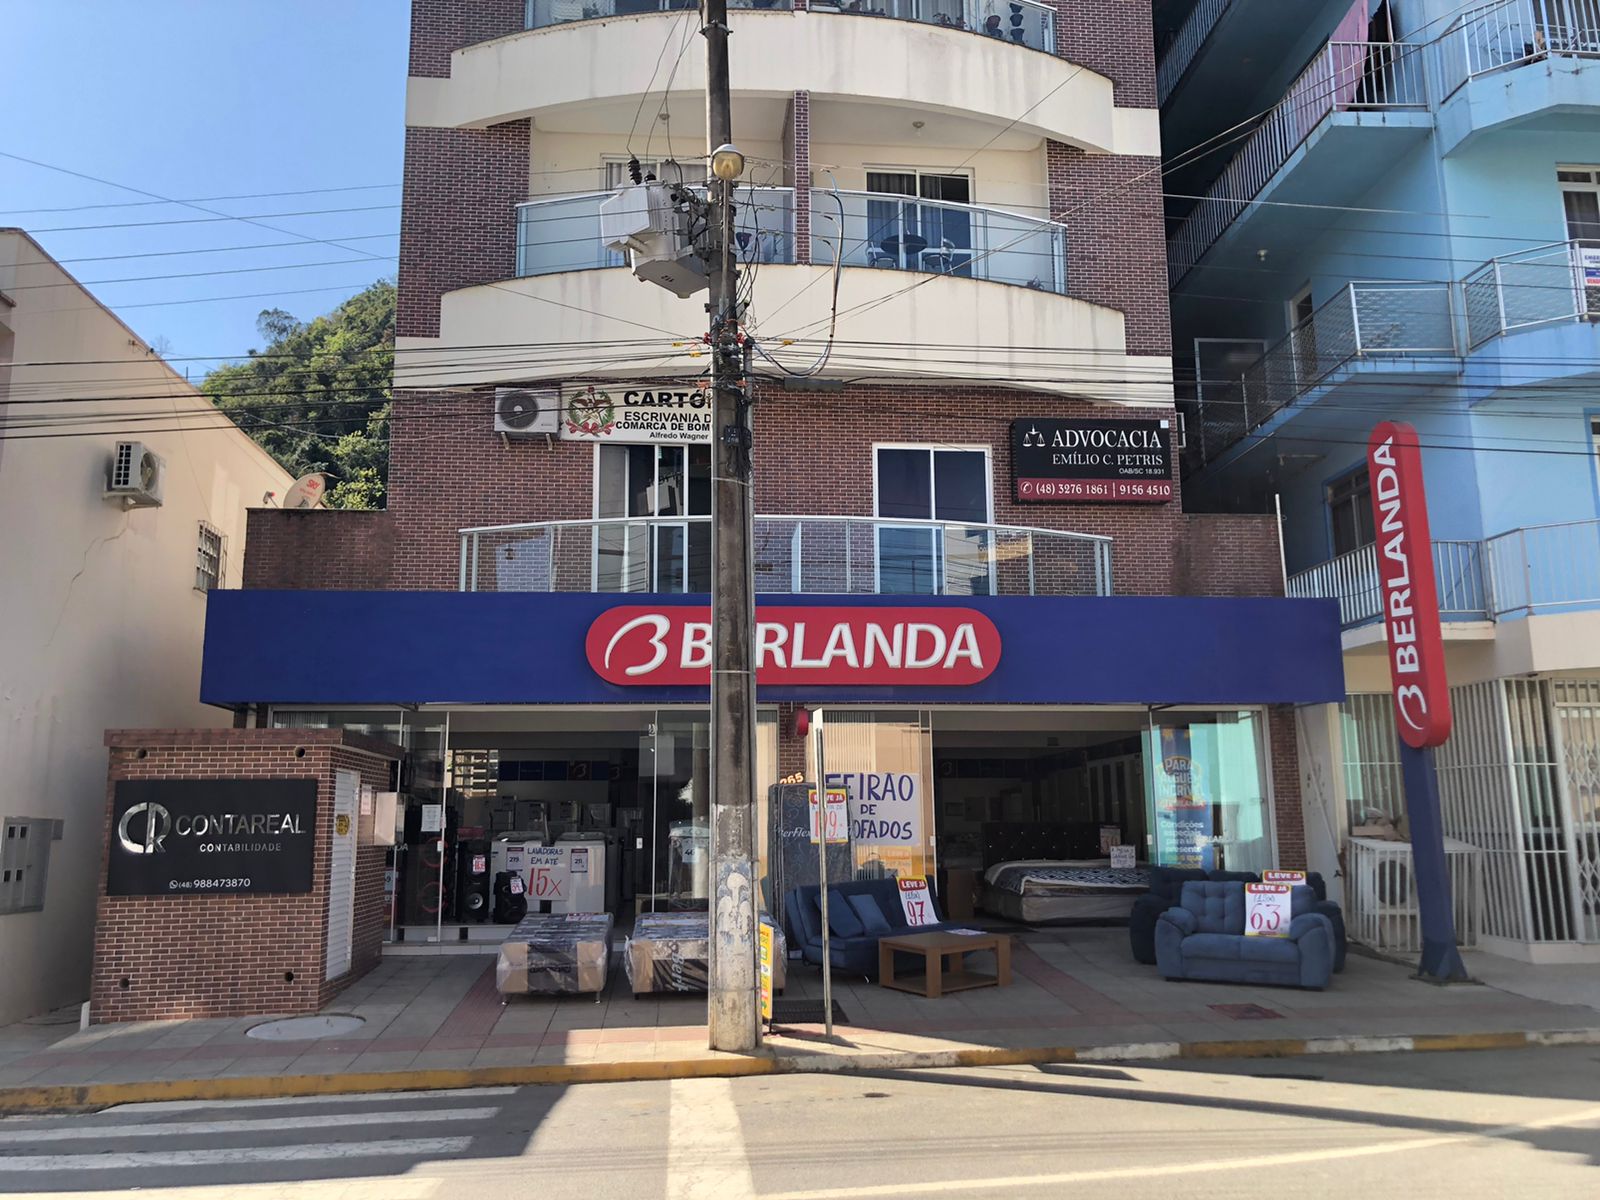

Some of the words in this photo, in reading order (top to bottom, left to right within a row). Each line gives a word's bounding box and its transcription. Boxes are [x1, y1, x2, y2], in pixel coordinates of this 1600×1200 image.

[625, 411, 700, 422] ESCRIVANIA
[616, 421, 667, 431] COMARCA
[671, 422, 684, 431] DE
[688, 423, 710, 431] BOM
[680, 432, 708, 441] Wagner
[1052, 430, 1162, 448] ADVOCACIA
[1053, 451, 1099, 465] EMÍLIO
[1103, 455, 1114, 465] C.
[1117, 454, 1163, 466] PETRIS
[1036, 483, 1055, 496] (48)
[1058, 483, 1082, 495] 3276
[1086, 484, 1108, 495] 1861
[1119, 484, 1144, 496] 9156
[1147, 484, 1171, 497] 4510
[1373, 435, 1420, 674] BERLANDA
[680, 622, 984, 669] BRLANDA
[861, 804, 877, 815] DE
[175, 813, 306, 836] CONTAREAL
[852, 820, 913, 840] OFADOS
[199, 842, 281, 853] CONTABILIDADE
[527, 847, 563, 856] LAVADORAS
[530, 857, 542, 865] EM
[178, 881, 193, 889] (48)
[193, 878, 251, 889] 988473870
[901, 880, 918, 888] LEVE
[1251, 883, 1276, 891] LEVE
[907, 901, 925, 925] 97
